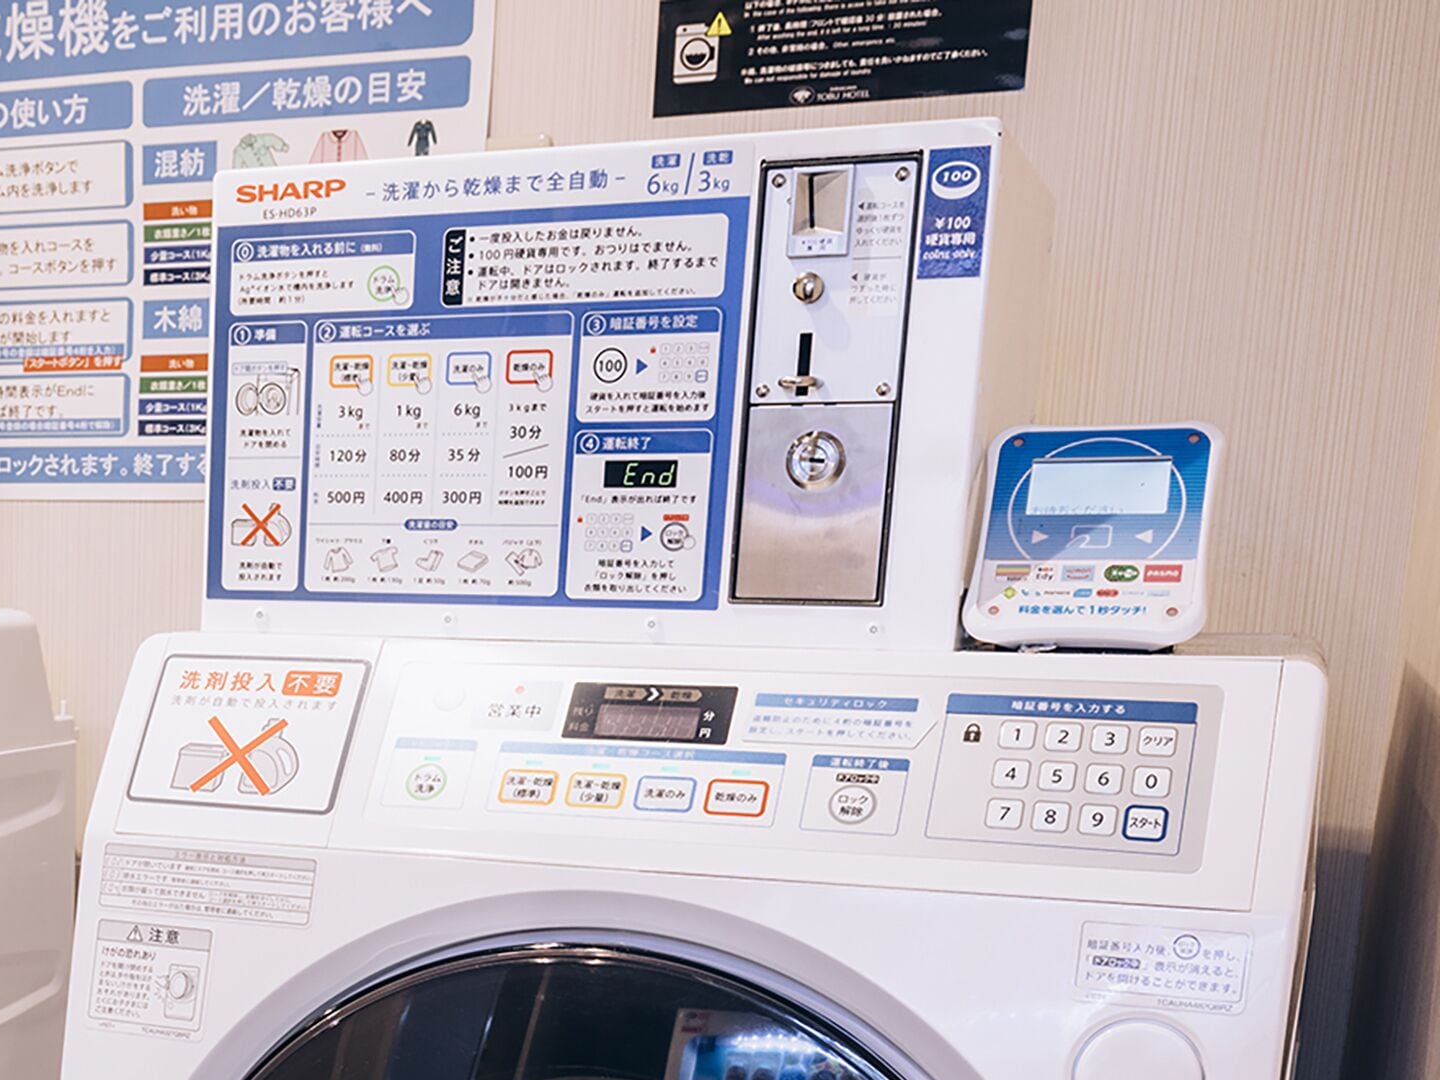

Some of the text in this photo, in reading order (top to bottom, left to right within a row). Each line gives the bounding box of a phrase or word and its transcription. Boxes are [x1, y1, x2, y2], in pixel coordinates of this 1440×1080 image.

[182, 68, 427, 117] 洗濯／乾燥の目安
[154, 149, 205, 179] 混紡
[647, 170, 731, 196] 6kg 3kg
[942, 169, 972, 183] 100
[235, 178, 347, 204] SHARP
[934, 216, 972, 231] ¥100
[479, 226, 643, 243] 一度投入したお金は戻りません。
[477, 277, 572, 291] ドアは開きません。
[154, 305, 203, 332] 木綿
[611, 314, 699, 331] 暗証番号を設定
[598, 360, 623, 373] 100
[338, 405, 364, 420] 3kg
[396, 404, 422, 419] 1kg
[453, 403, 481, 419] 6kg
[510, 425, 542, 440] 30分
[602, 437, 652, 451] 運転終了
[330, 449, 367, 463] 120分
[389, 449, 421, 463] 80分
[448, 448, 481, 463] 35分
[508, 465, 548, 480] 100円
[623, 462, 675, 486] End
[327, 490, 366, 505] 500円
[383, 490, 423, 505] 400円
[442, 490, 482, 505] 300円
[179, 670, 339, 696] 洗剤投入 不要
[171, 694, 338, 711] 洗剤が自動で投入されます
[784, 696, 888, 710] セキュリティロック
[1011, 699, 1127, 715] 暗証番号を入力する
[703, 710, 715, 722] 分
[698, 727, 711, 739] 円
[1015, 728, 1173, 747] 1 2 3 クリア
[1005, 767, 1158, 789] 4 5 6 0
[644, 789, 686, 800] 洗濯のみ
[714, 791, 758, 804] 乾燥のみ
[838, 794, 869, 805] ロック
[839, 806, 864, 817] 解除
[1000, 806, 1162, 829] 7 8 9 スタート
[148, 927, 180, 944] 注意
